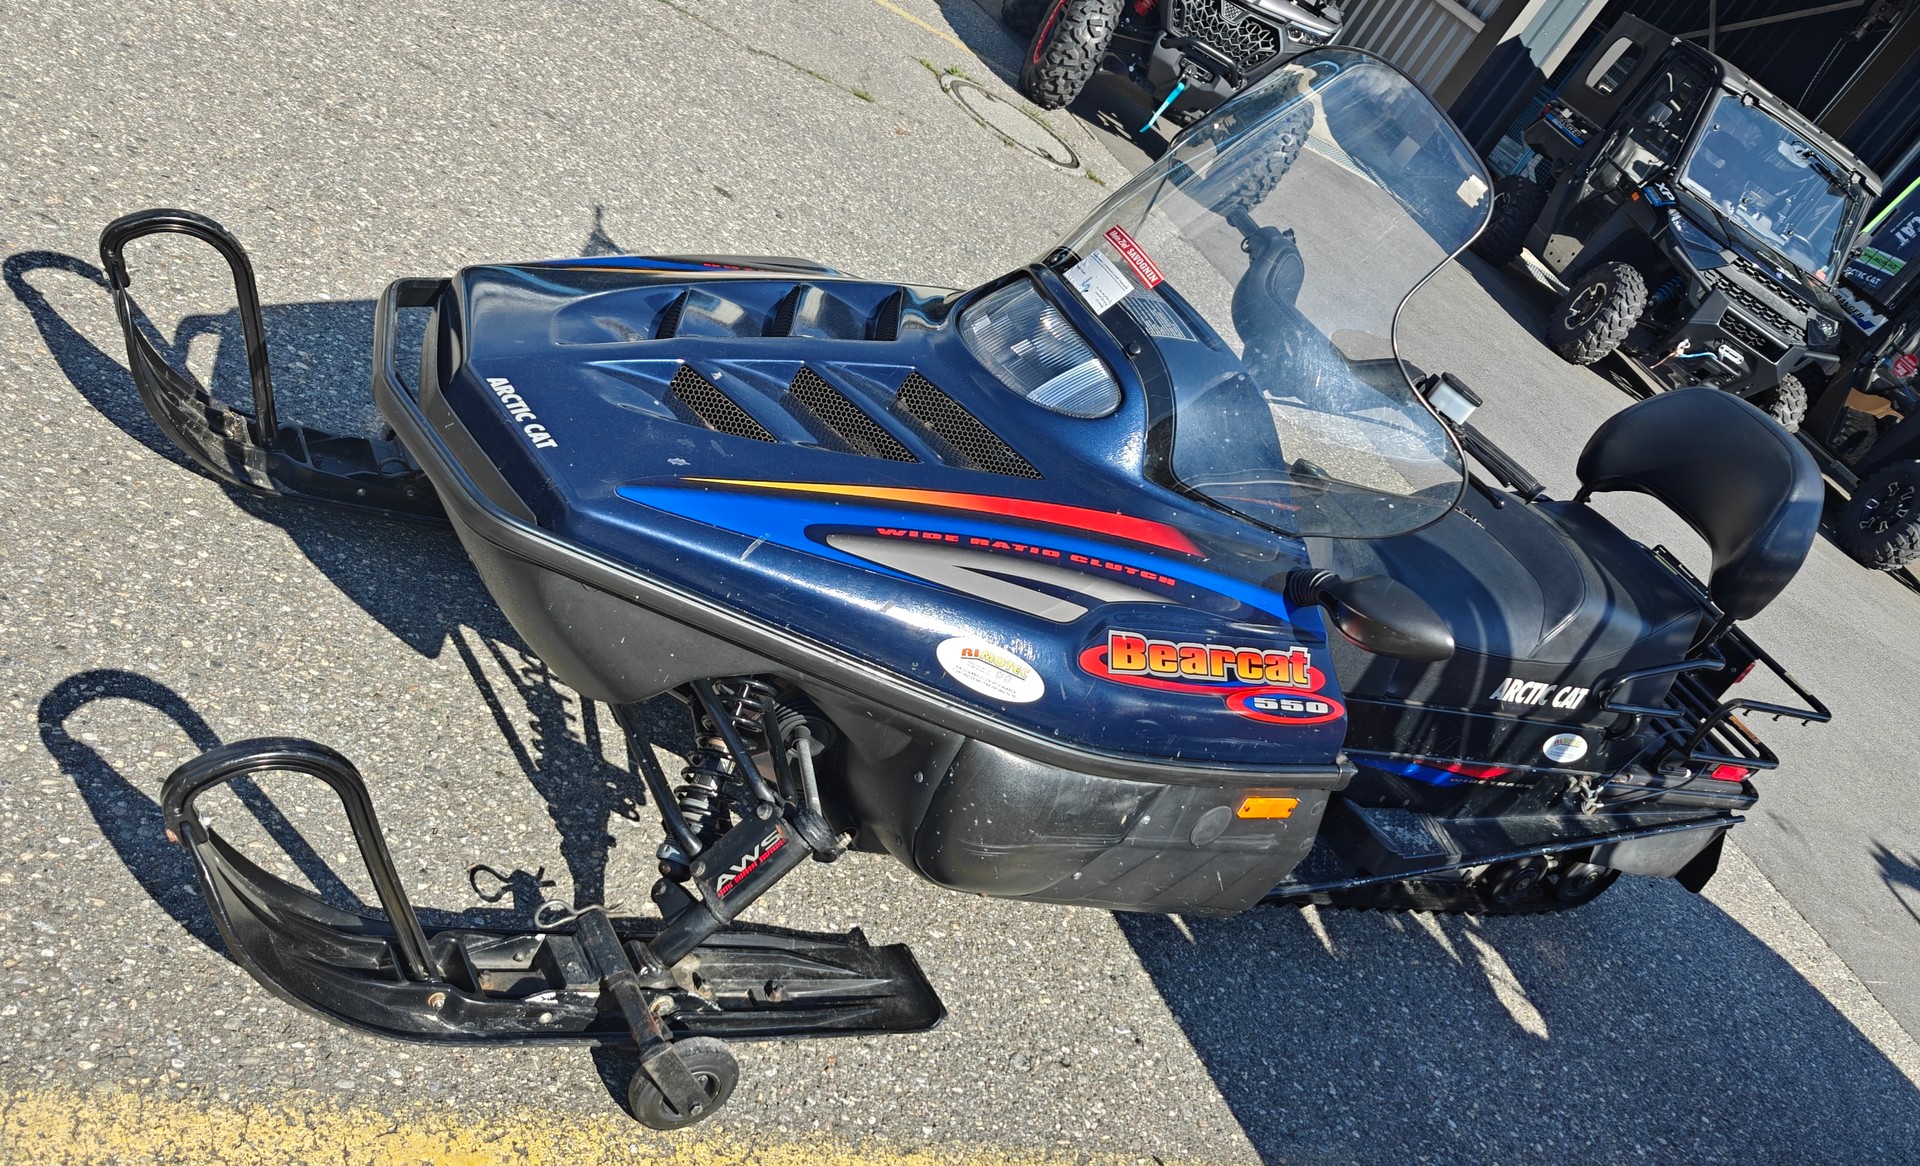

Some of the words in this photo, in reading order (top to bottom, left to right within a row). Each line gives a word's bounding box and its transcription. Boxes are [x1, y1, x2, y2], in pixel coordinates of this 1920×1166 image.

[1655, 182, 1676, 201] XP
[1126, 248, 1159, 283] SAVOGNIN
[1835, 294, 1865, 318] RANGER
[486, 378, 537, 423] ARCTIC
[524, 423, 559, 449] CAT
[876, 527, 959, 542] WIDE
[970, 537, 1061, 558] RATIO
[1069, 553, 1176, 587] CLUTCH
[961, 648, 1031, 679] RIMOTEC
[1109, 632, 1310, 687] Bearcat
[1253, 696, 1330, 714] 550
[1489, 677, 1557, 706] ARCTIC
[1551, 686, 1590, 710] CAT
[716, 828, 784, 892] AWS
